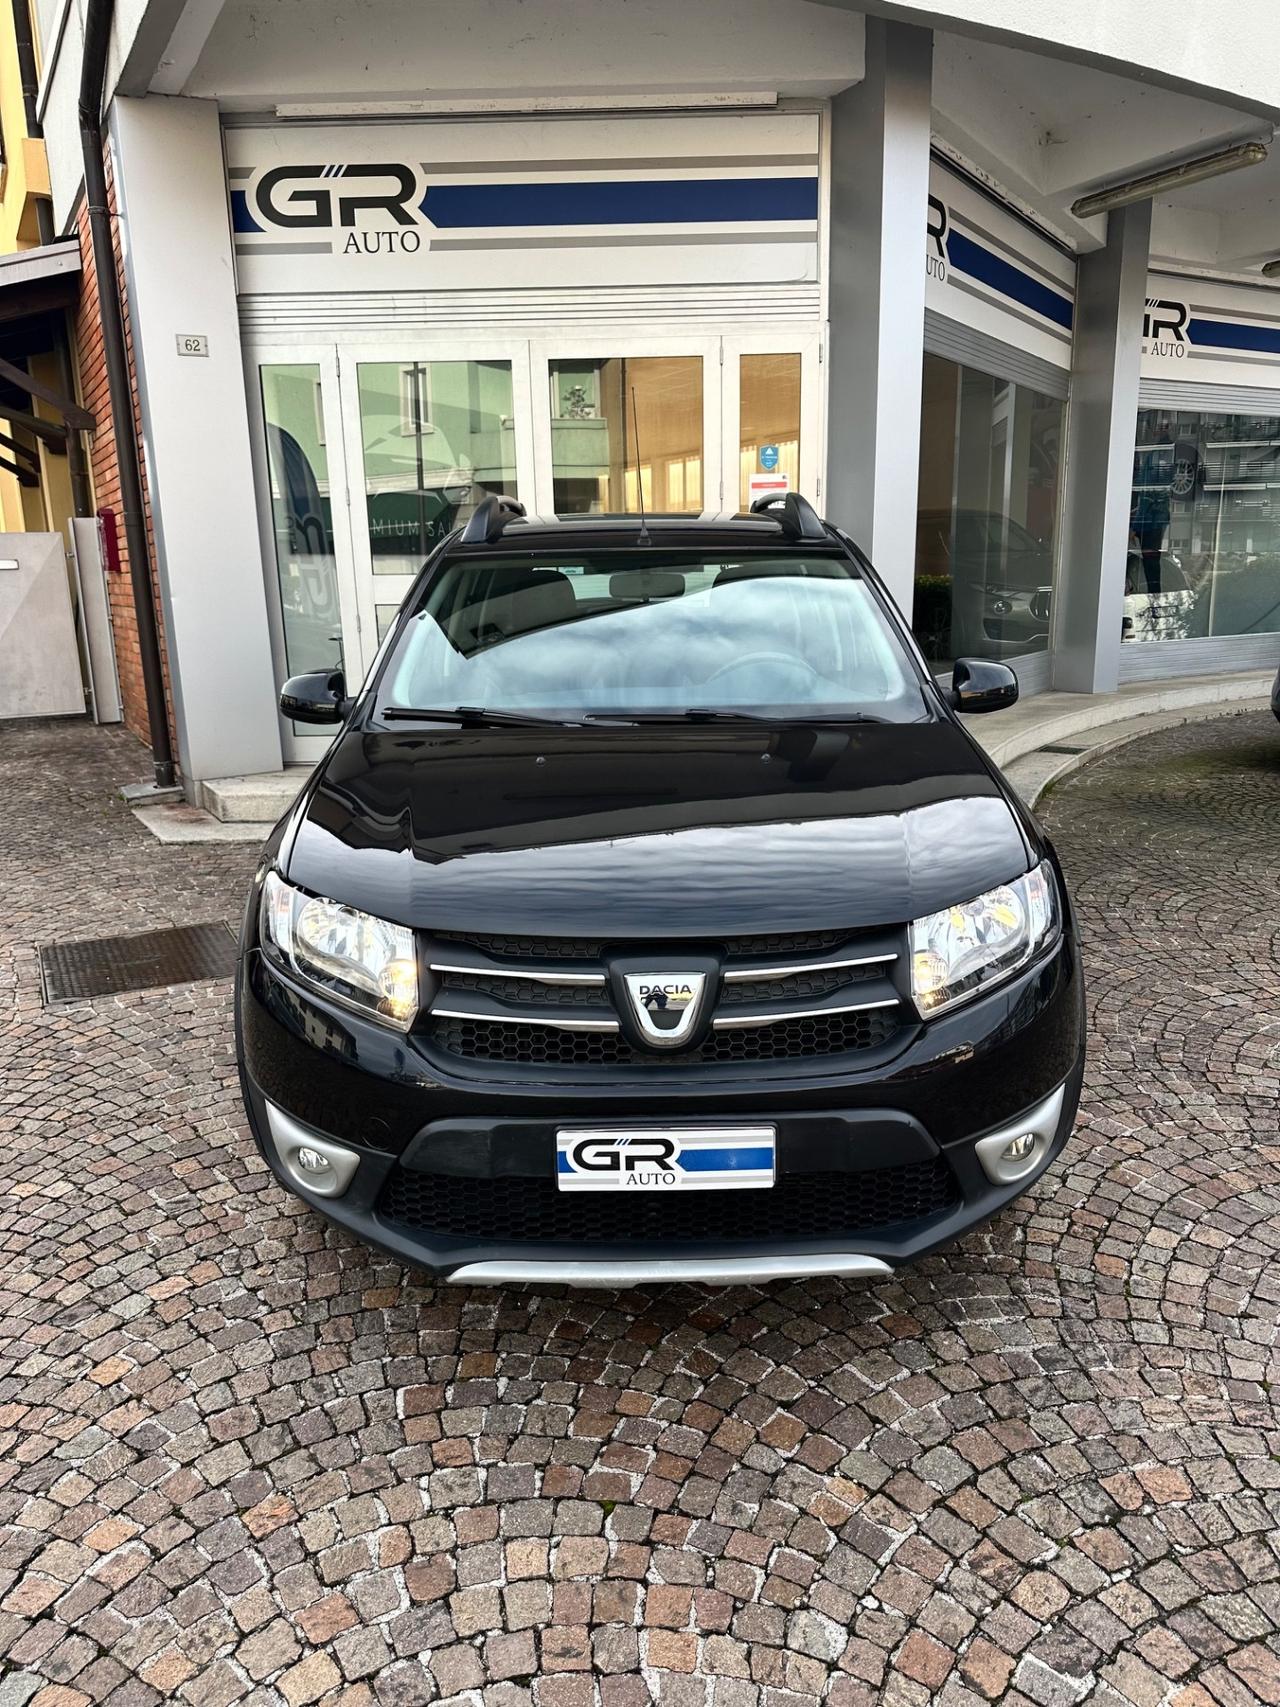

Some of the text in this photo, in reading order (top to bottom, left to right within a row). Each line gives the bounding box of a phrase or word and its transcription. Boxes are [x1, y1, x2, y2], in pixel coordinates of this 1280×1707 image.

[256, 163, 419, 228] GR
[343, 230, 420, 254] AUTO
[185, 339, 201, 351] 62
[1151, 341, 1185, 358] AUTO
[639, 984, 692, 995] DACIA
[573, 1138, 675, 1171] GR
[626, 1172, 676, 1185] AUTO
